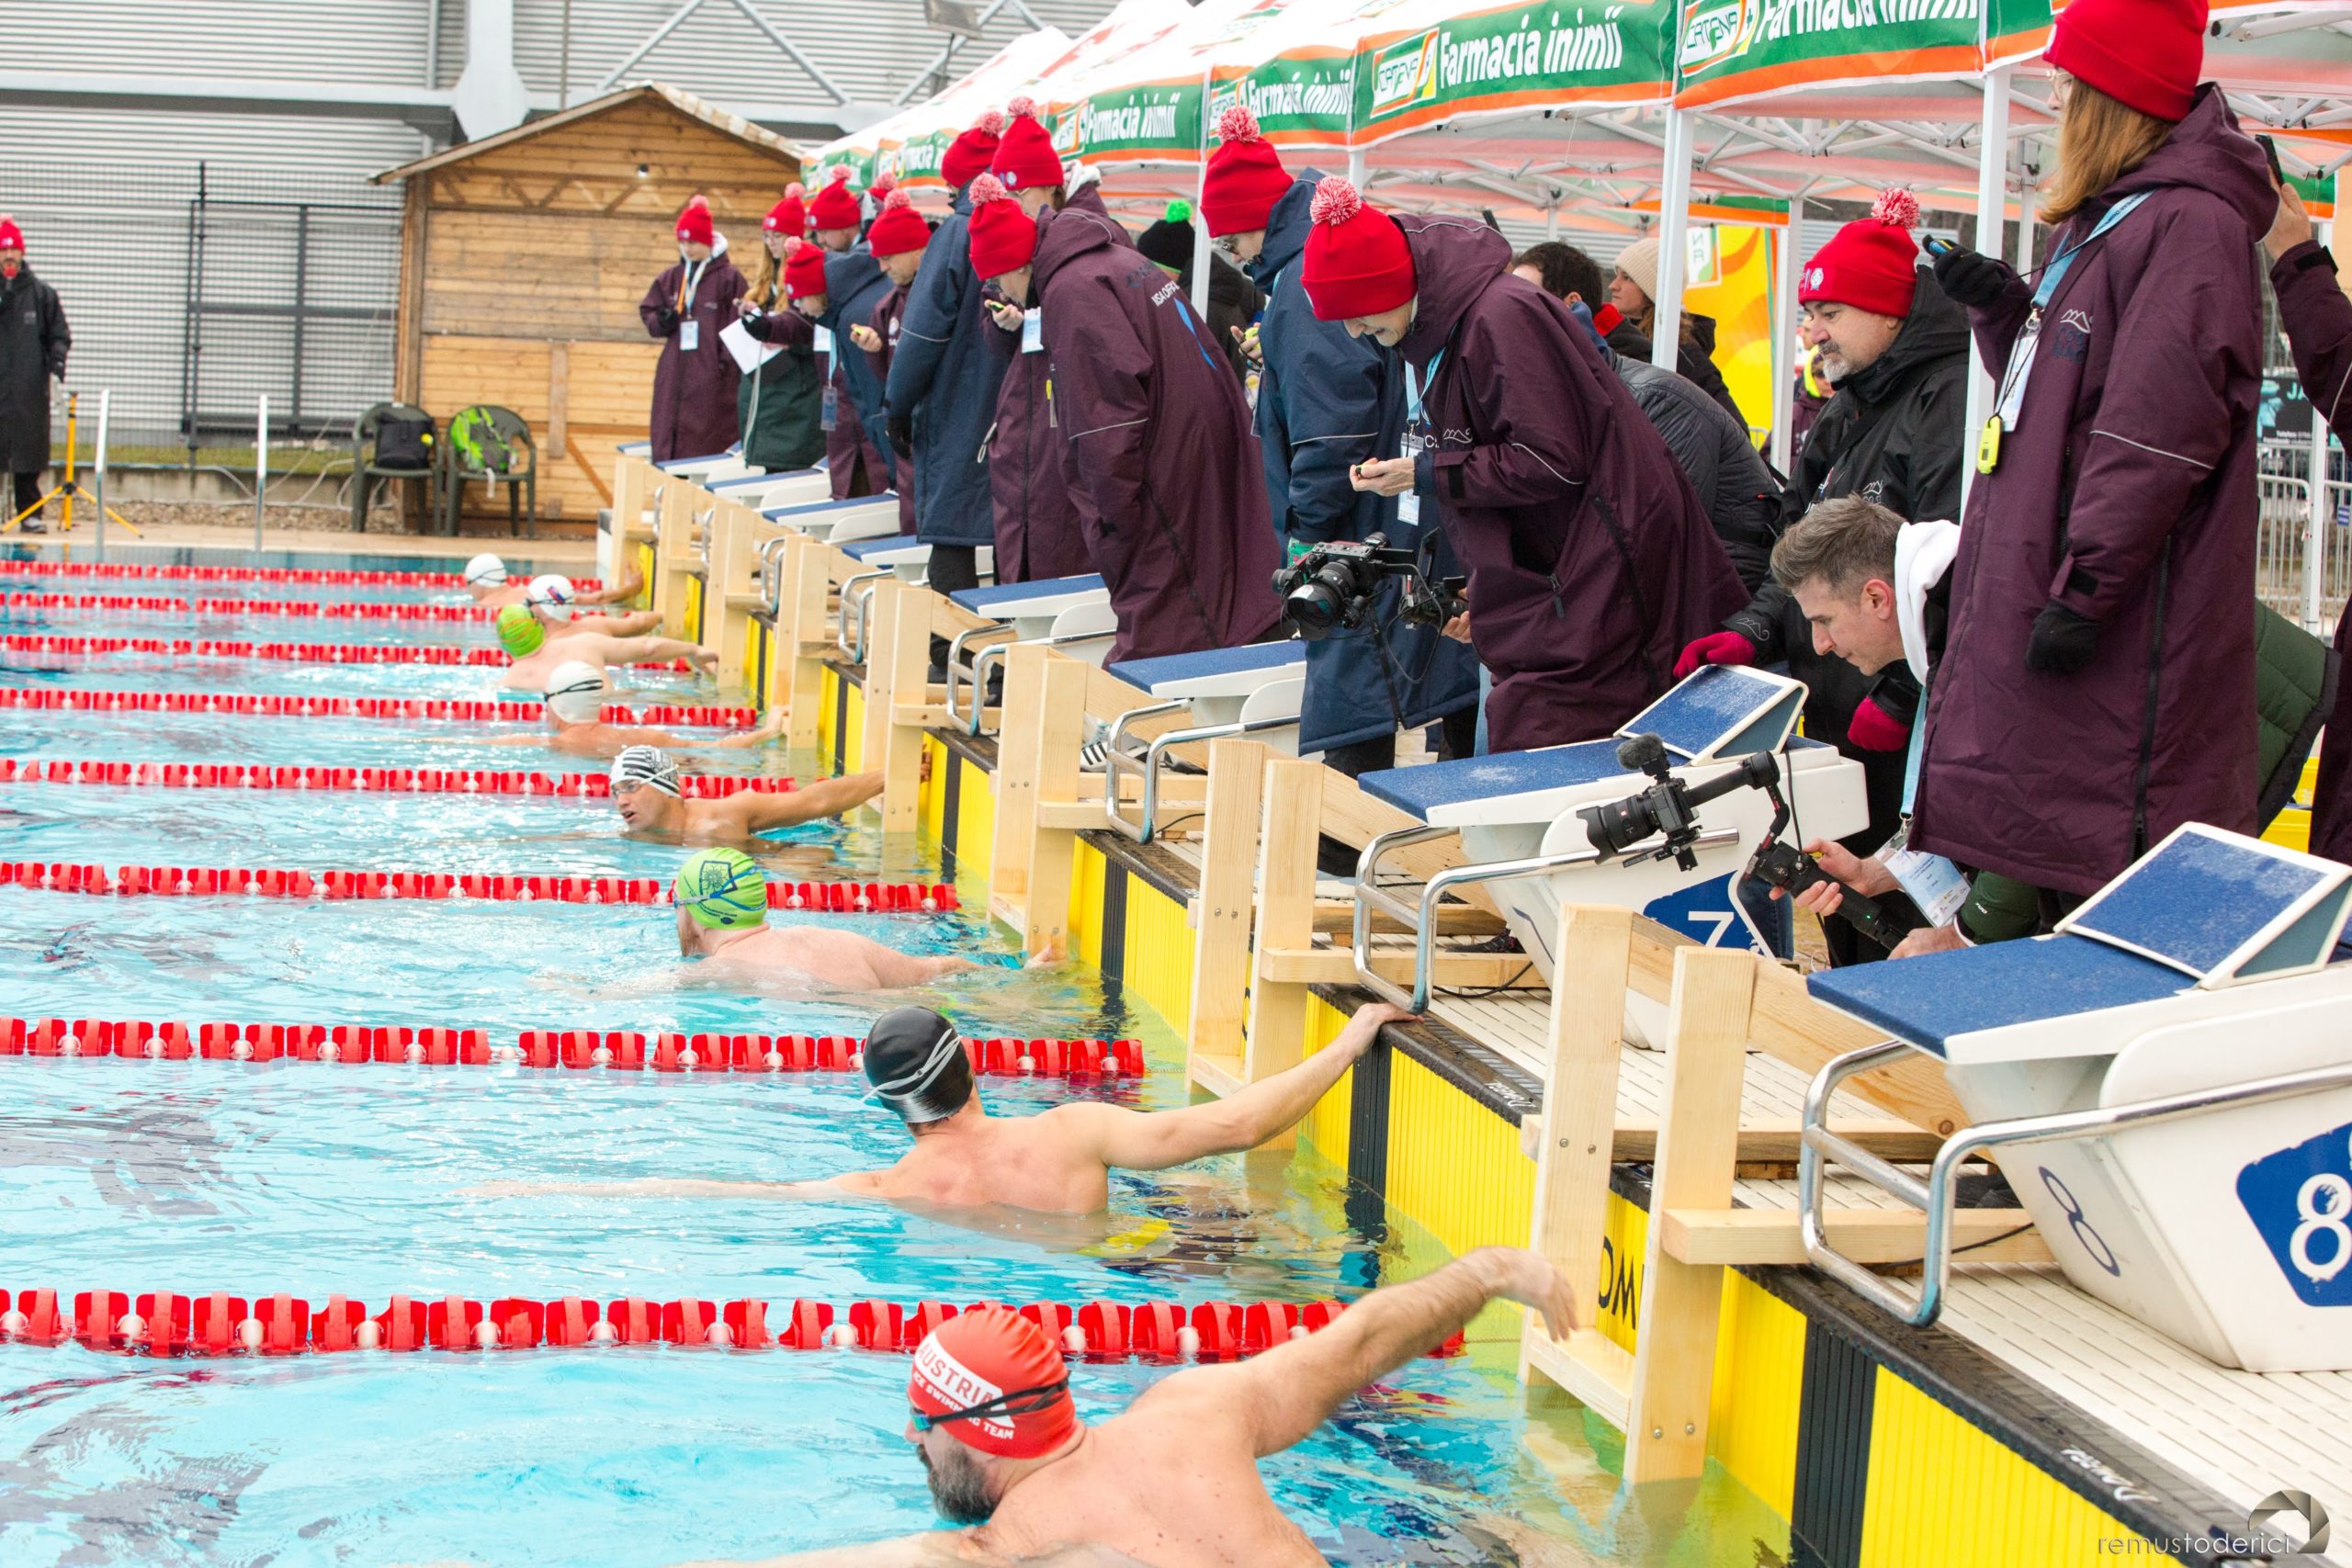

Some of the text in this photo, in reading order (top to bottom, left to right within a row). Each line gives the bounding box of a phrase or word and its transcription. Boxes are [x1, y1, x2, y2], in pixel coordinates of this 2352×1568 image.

[1441, 14, 1542, 89] Farmacia
[1544, 5, 1624, 74] inimii
[1687, 11, 1738, 49] CATENA
[1085, 93, 1142, 144] Farmacia
[1688, 910, 1735, 948] 7
[2039, 1166, 2120, 1277] 8
[2290, 1172, 2352, 1282] 8
[920, 1342, 995, 1405] AUSTRIA
[983, 1420, 1014, 1439] TEAM
